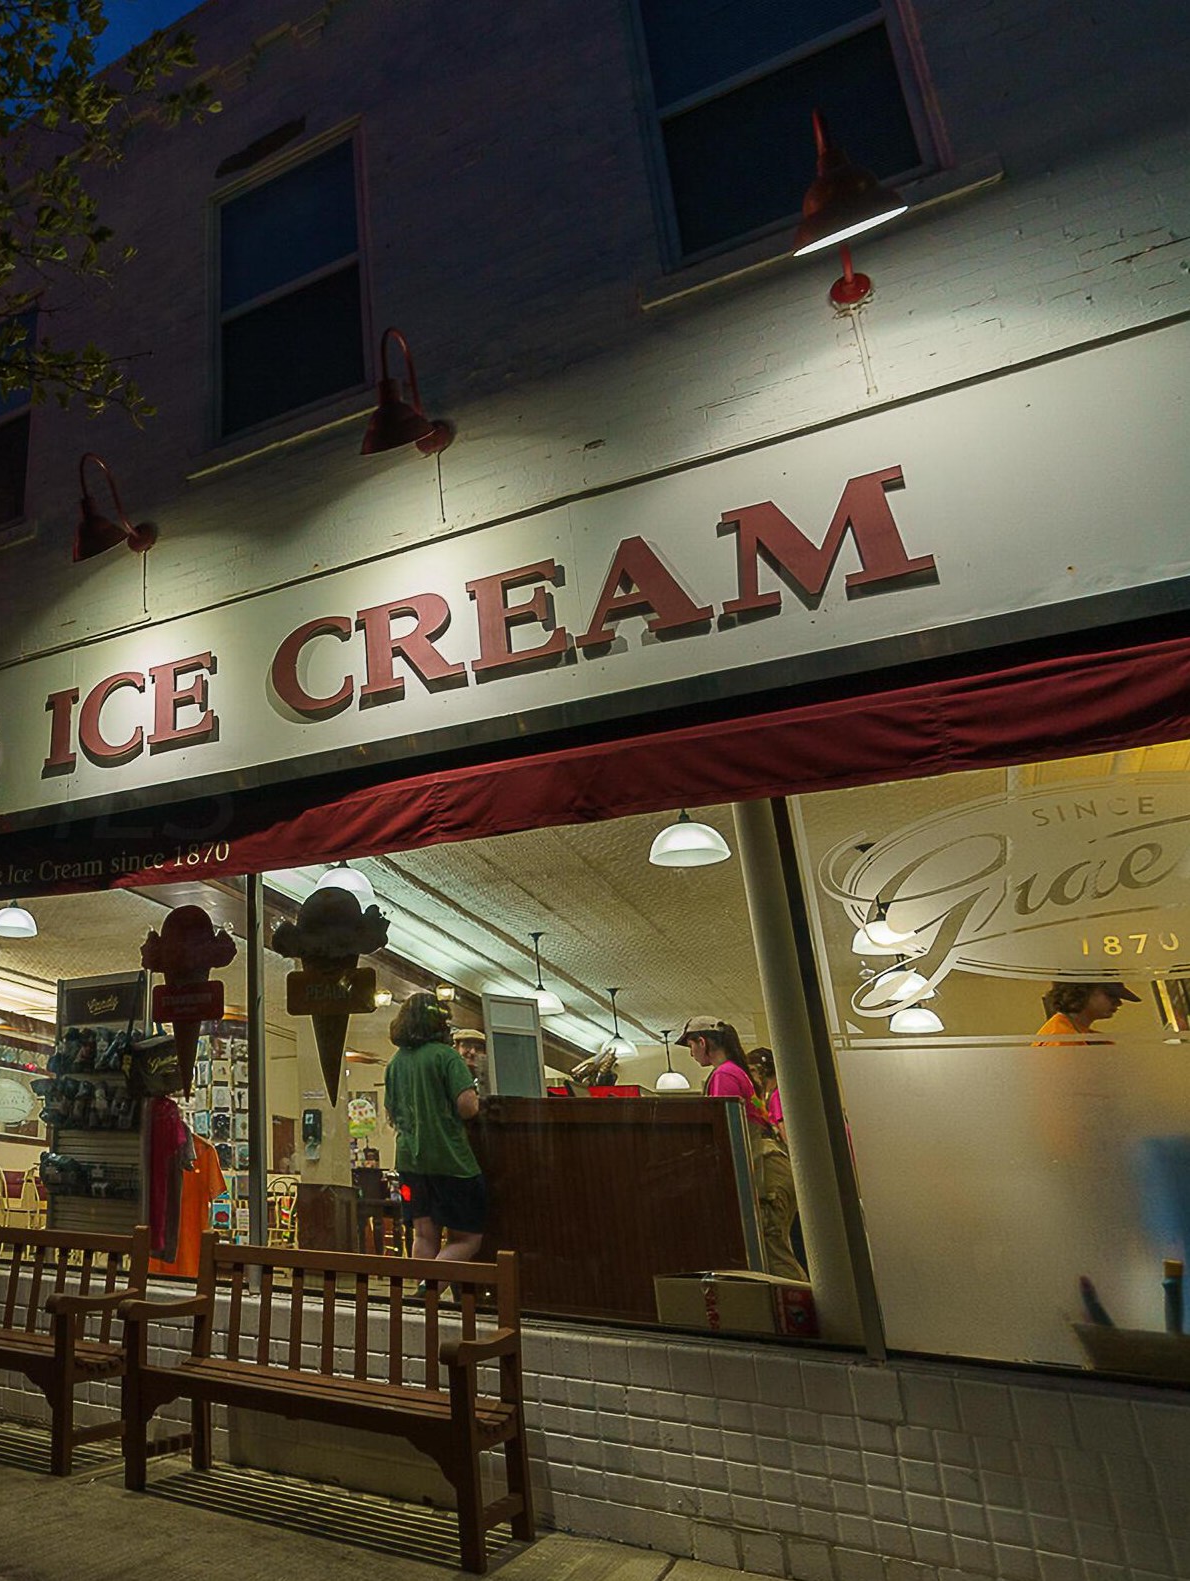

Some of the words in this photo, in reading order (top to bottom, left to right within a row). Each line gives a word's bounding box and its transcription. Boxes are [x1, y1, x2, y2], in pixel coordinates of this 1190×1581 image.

[41, 650, 220, 780] ICE
[266, 464, 940, 725] CREAM
[1031, 795, 1157, 827] SINCE
[8, 864, 36, 886] Ice
[38, 858, 104, 882] Cream
[111, 848, 165, 873] since
[173, 839, 231, 868] 1870
[1081, 931, 1181, 956] 1870
